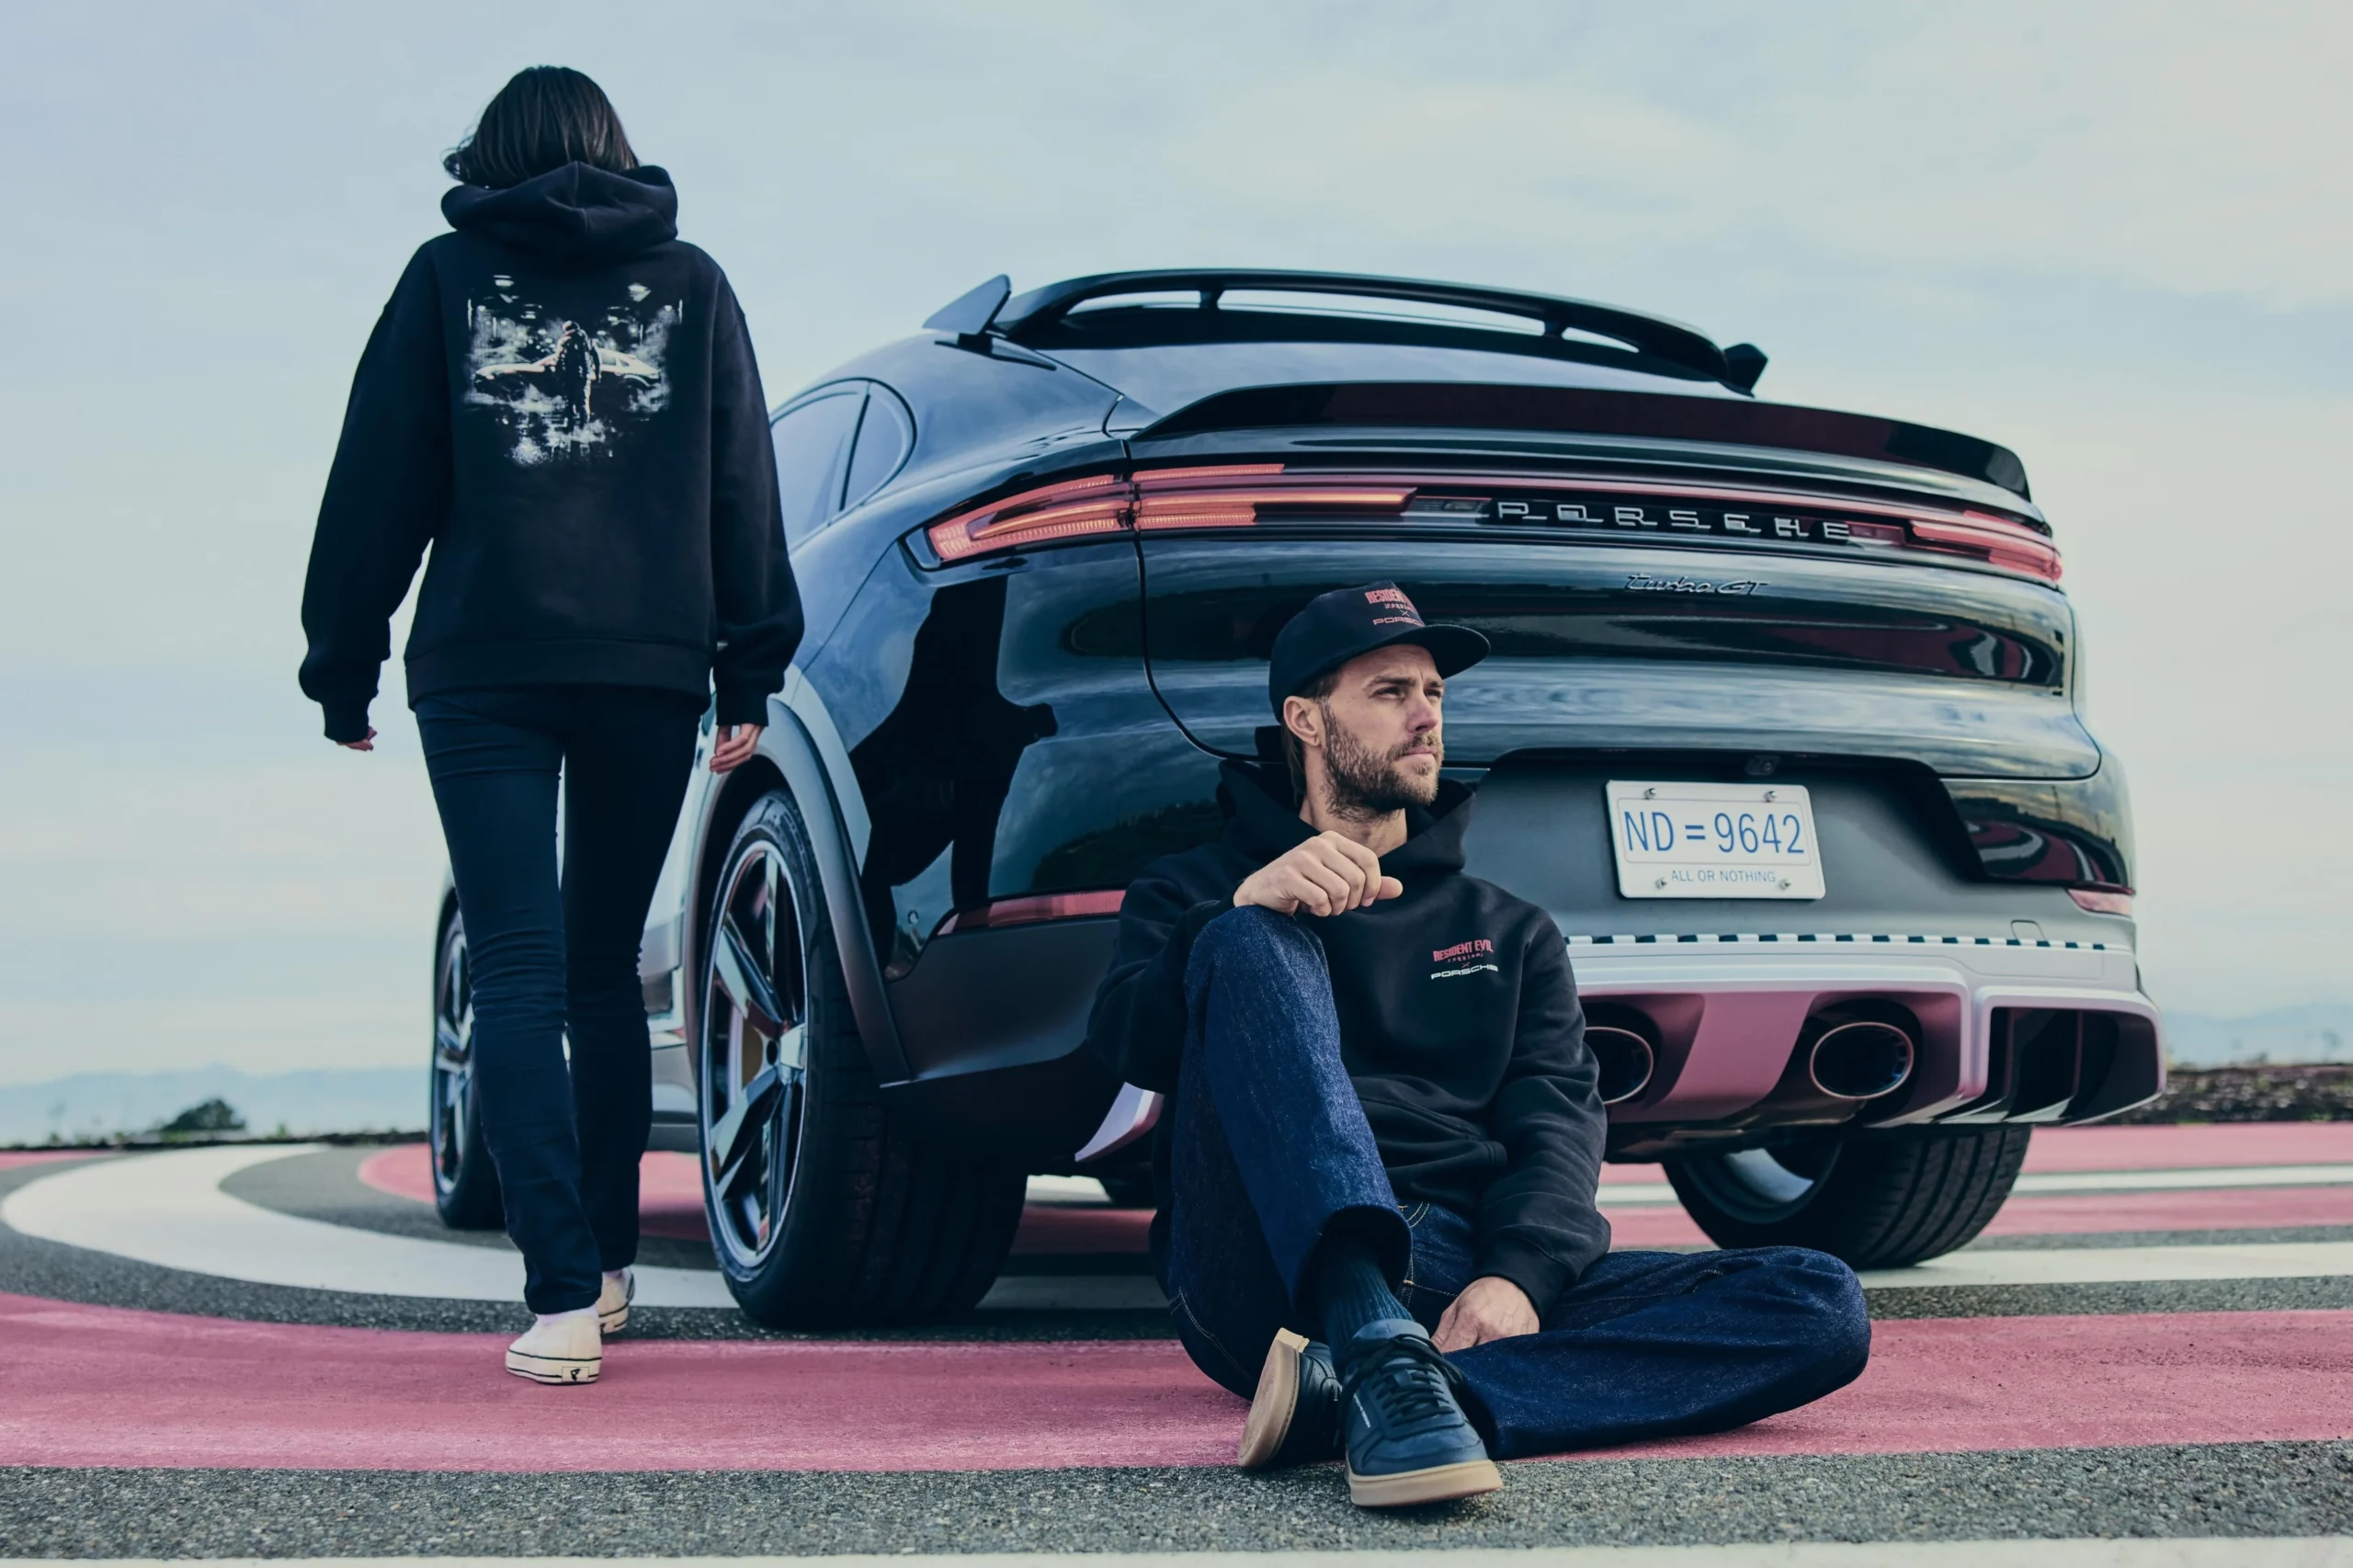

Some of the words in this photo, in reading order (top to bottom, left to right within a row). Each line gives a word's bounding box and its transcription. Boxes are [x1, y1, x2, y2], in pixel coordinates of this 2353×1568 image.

[1498, 502, 1849, 540] PORSCHE
[1715, 580, 1769, 596] GT
[1624, 811, 1675, 852] ND
[1713, 812, 1805, 854] 9642
[1671, 869, 1693, 882] ALL
[1698, 869, 1716, 882] OR
[1720, 870, 1777, 883] NOTHING
[1433, 942, 1472, 961] RESIDENT
[1474, 939, 1494, 952] EVIL
[1431, 964, 1498, 979] PORSCHE
